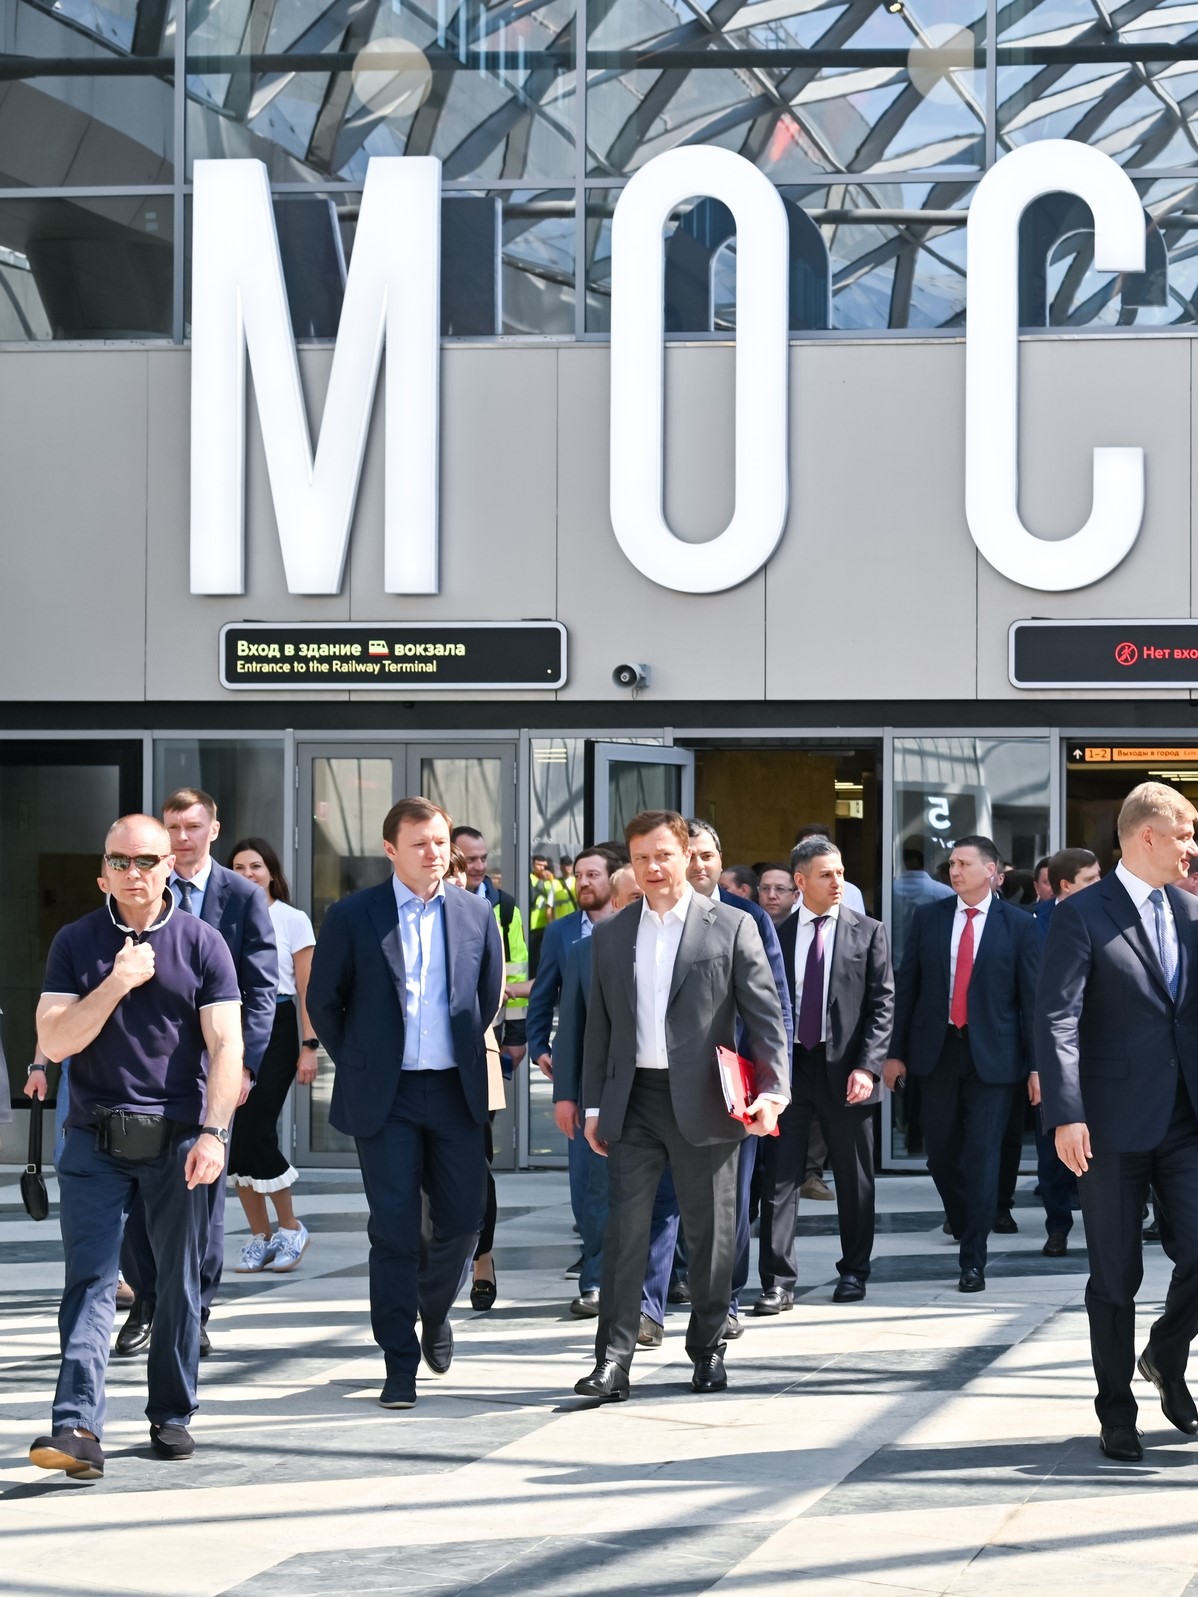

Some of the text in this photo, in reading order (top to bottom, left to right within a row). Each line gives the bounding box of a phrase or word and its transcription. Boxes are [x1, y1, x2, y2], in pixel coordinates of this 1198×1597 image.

[238, 641, 465, 658] Вход в здание вокзала
[1144, 647, 1170, 658] Нет
[237, 660, 436, 674] Entrance to the Railway Terminal
[1089, 750, 1107, 758] 1-2
